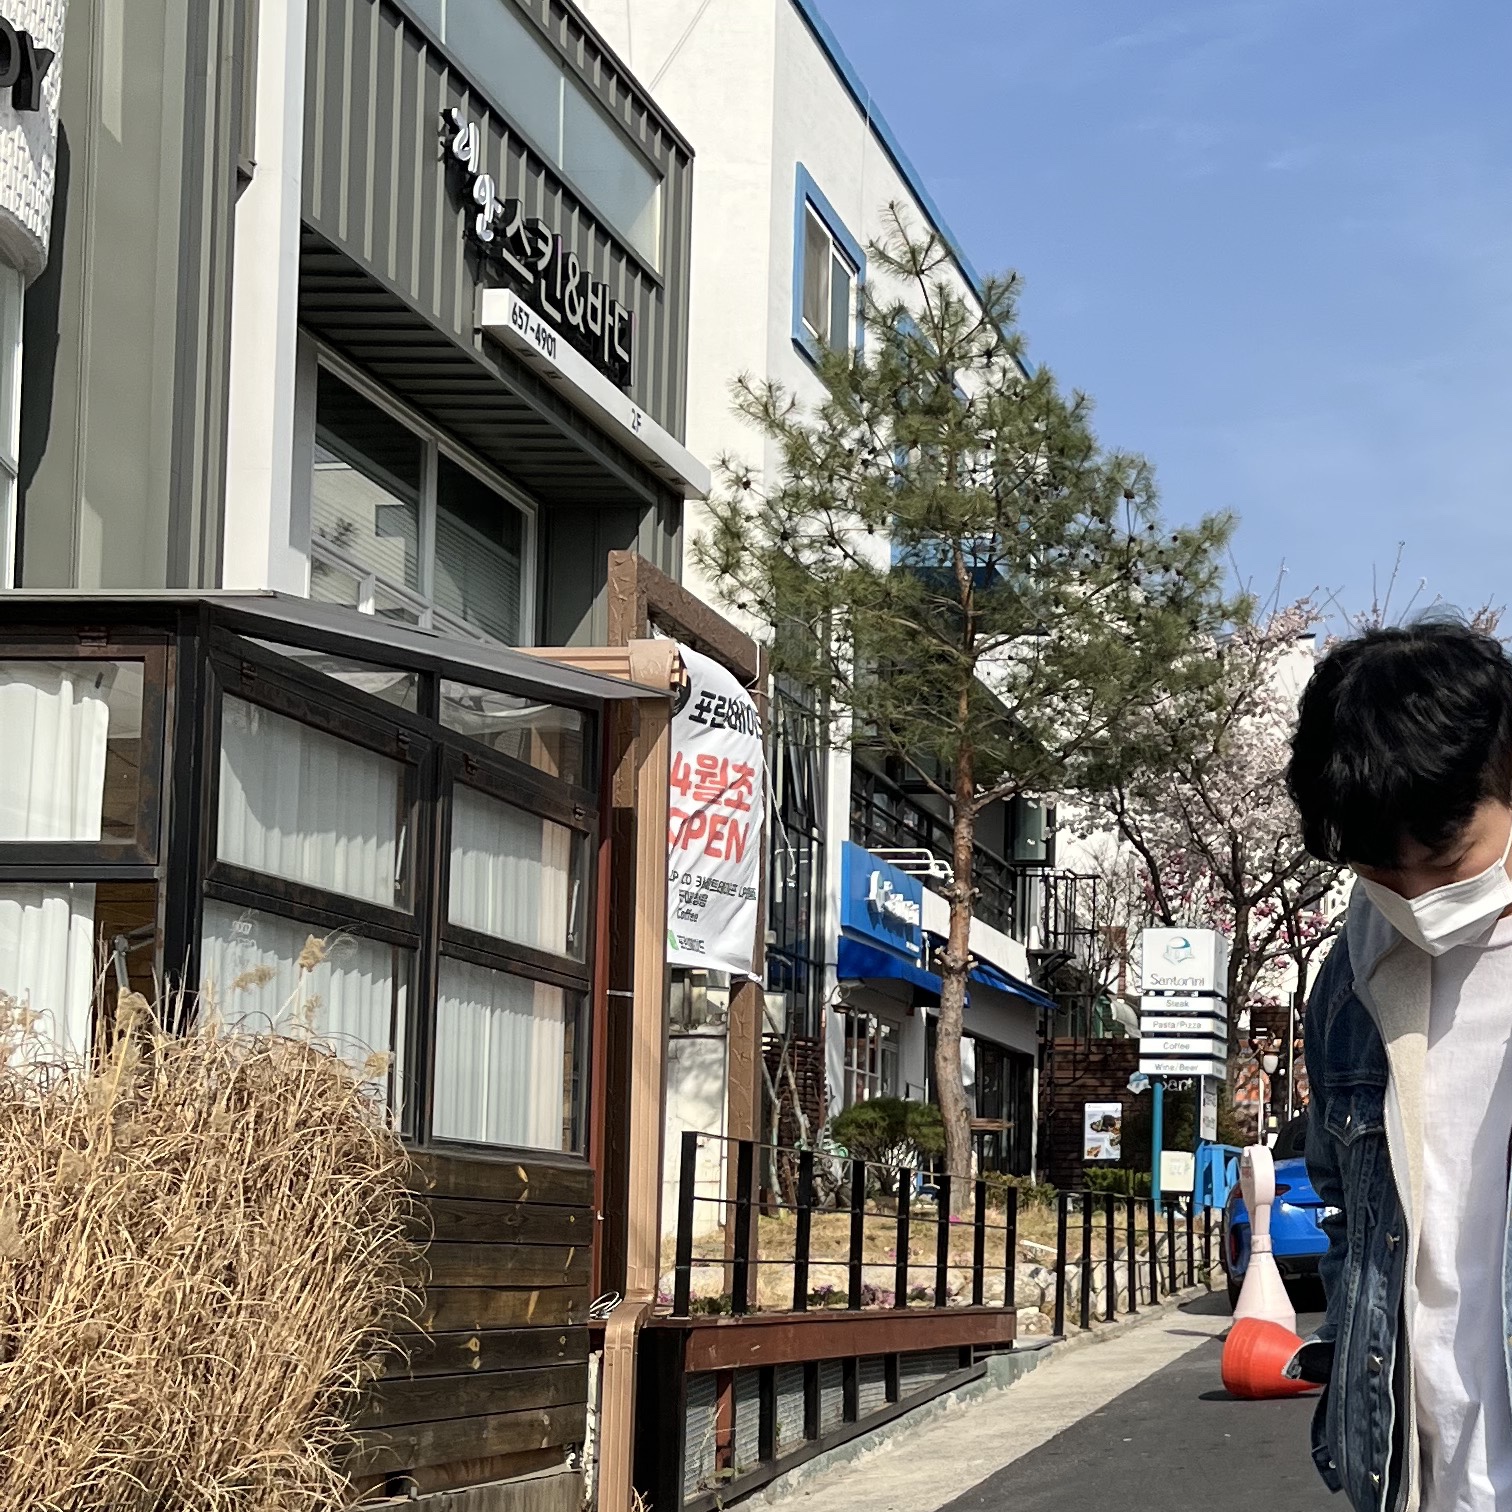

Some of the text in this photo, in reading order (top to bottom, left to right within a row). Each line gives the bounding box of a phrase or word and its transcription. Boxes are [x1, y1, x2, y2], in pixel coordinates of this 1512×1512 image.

[511, 302, 557, 360] 657-4901
[631, 407, 642, 433] 2F
[671, 750, 755, 812] 4월초
[1150, 973, 1204, 987] Santorini
[1166, 999, 1189, 1008] Steak
[1153, 1020, 1202, 1029] Pasta/Pizza
[1163, 1041, 1190, 1050] Coffee
[1154, 1062, 1198, 1071] Wine/Beer
